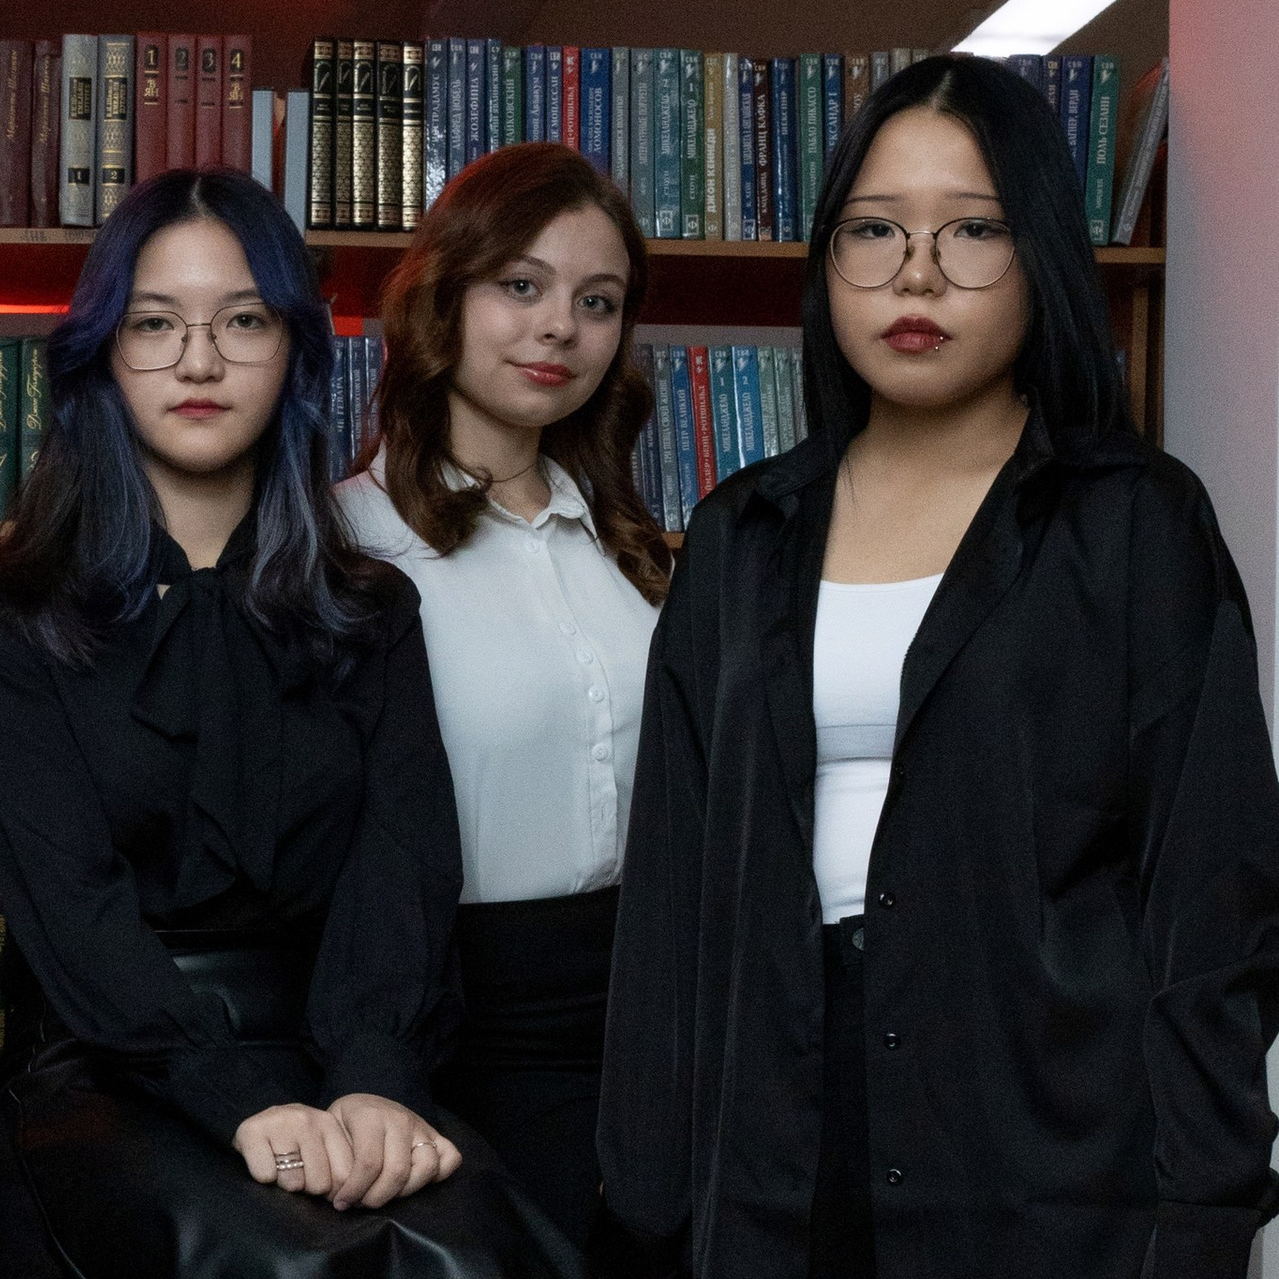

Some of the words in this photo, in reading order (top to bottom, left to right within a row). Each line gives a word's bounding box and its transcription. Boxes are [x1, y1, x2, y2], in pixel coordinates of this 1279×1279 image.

[148, 50, 155, 65] 1
[179, 52, 186, 66] 2
[207, 52, 214, 68] 3
[231, 52, 241, 68] 4
[551, 76, 559, 126] МОПАССАН
[663, 79, 669, 88] 2
[470, 77, 479, 141] ЖОЗЕФИНА
[504, 79, 515, 144] ЧАЙКОВСКИЙ
[594, 88, 603, 154] ЛОМОНОСОВ
[757, 94, 766, 129] КАФКА
[781, 91, 789, 136] ШЕКСПИР
[807, 86, 817, 125] ПИКАССО
[1099, 96, 1110, 135] СЕЗАНН
[661, 94, 671, 155] МИКЕЛАНДЖЕЛО
[687, 99, 696, 159] МИКЕЛАНДЖЕЛО
[809, 127, 818, 154] ПАБЛО
[706, 128, 716, 177] КЕННЕДИ
[759, 130, 768, 167] ФРАНЦ
[1097, 137, 1108, 164] ПОЛЬ
[707, 178, 717, 213] ДЖОН
[660, 379, 668, 404] ЖИЗНИ
[742, 376, 749, 385] 2
[338, 418, 345, 432] ЧЕ
[661, 405, 670, 427] СВОЕЙ
[678, 389, 688, 429] ВЕЛИКИЙ
[719, 394, 731, 453] МИКЕЛАНДЖЕЛО
[742, 392, 755, 451] МИКЕЛАНДЖЕЛО
[664, 451, 672, 463] ТРИ
[681, 430, 690, 451] ПЕТР
